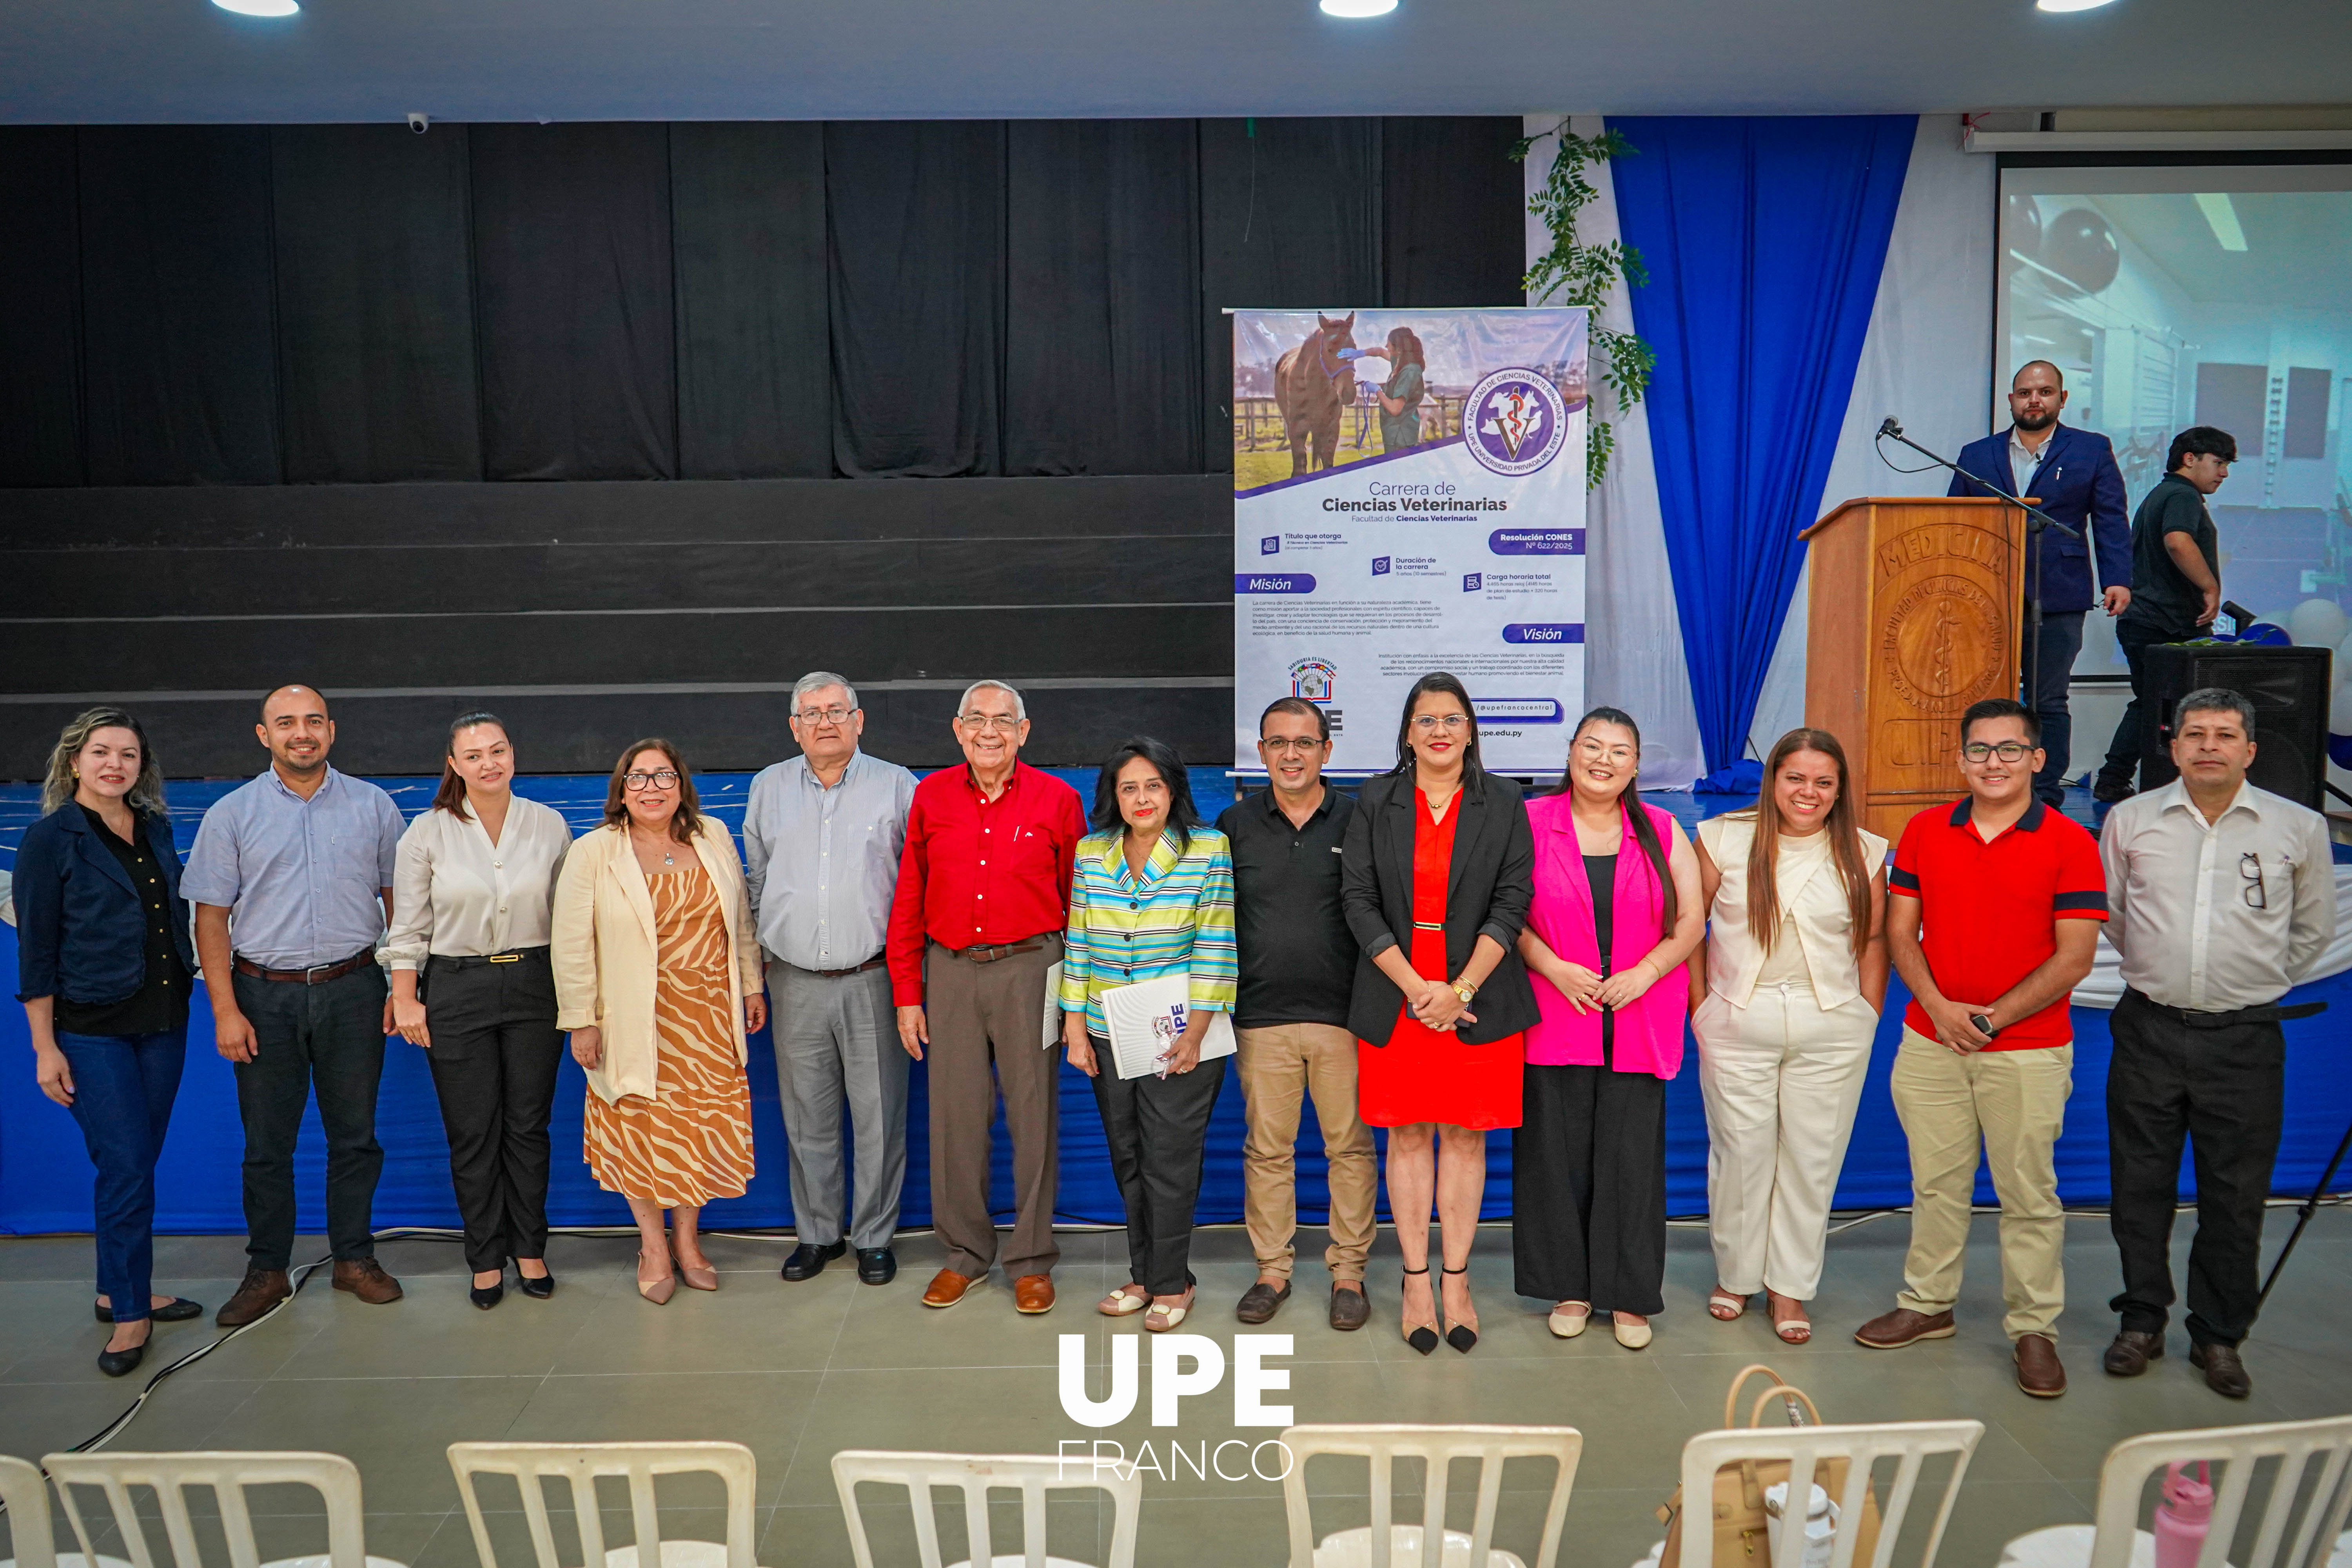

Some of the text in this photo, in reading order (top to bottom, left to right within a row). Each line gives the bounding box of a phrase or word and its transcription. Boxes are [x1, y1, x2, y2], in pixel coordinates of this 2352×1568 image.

[1468, 372, 1563, 421] FACULTAD DE CIENCIAS VETERINARIAS
[1468, 432, 1561, 472] UPE UNIVERSIDAD PRIVADA DEL ESTE
[1369, 481, 1456, 496] Carrera de
[1322, 497, 1507, 512] Ciencias Veterinarias
[1537, 541, 1573, 550] 622/2025
[1878, 525, 2003, 577] MEDICINA
[1249, 578, 1292, 590] Misión
[1523, 628, 1562, 640] Visión
[1318, 657, 1338, 670] LIBERTAD
